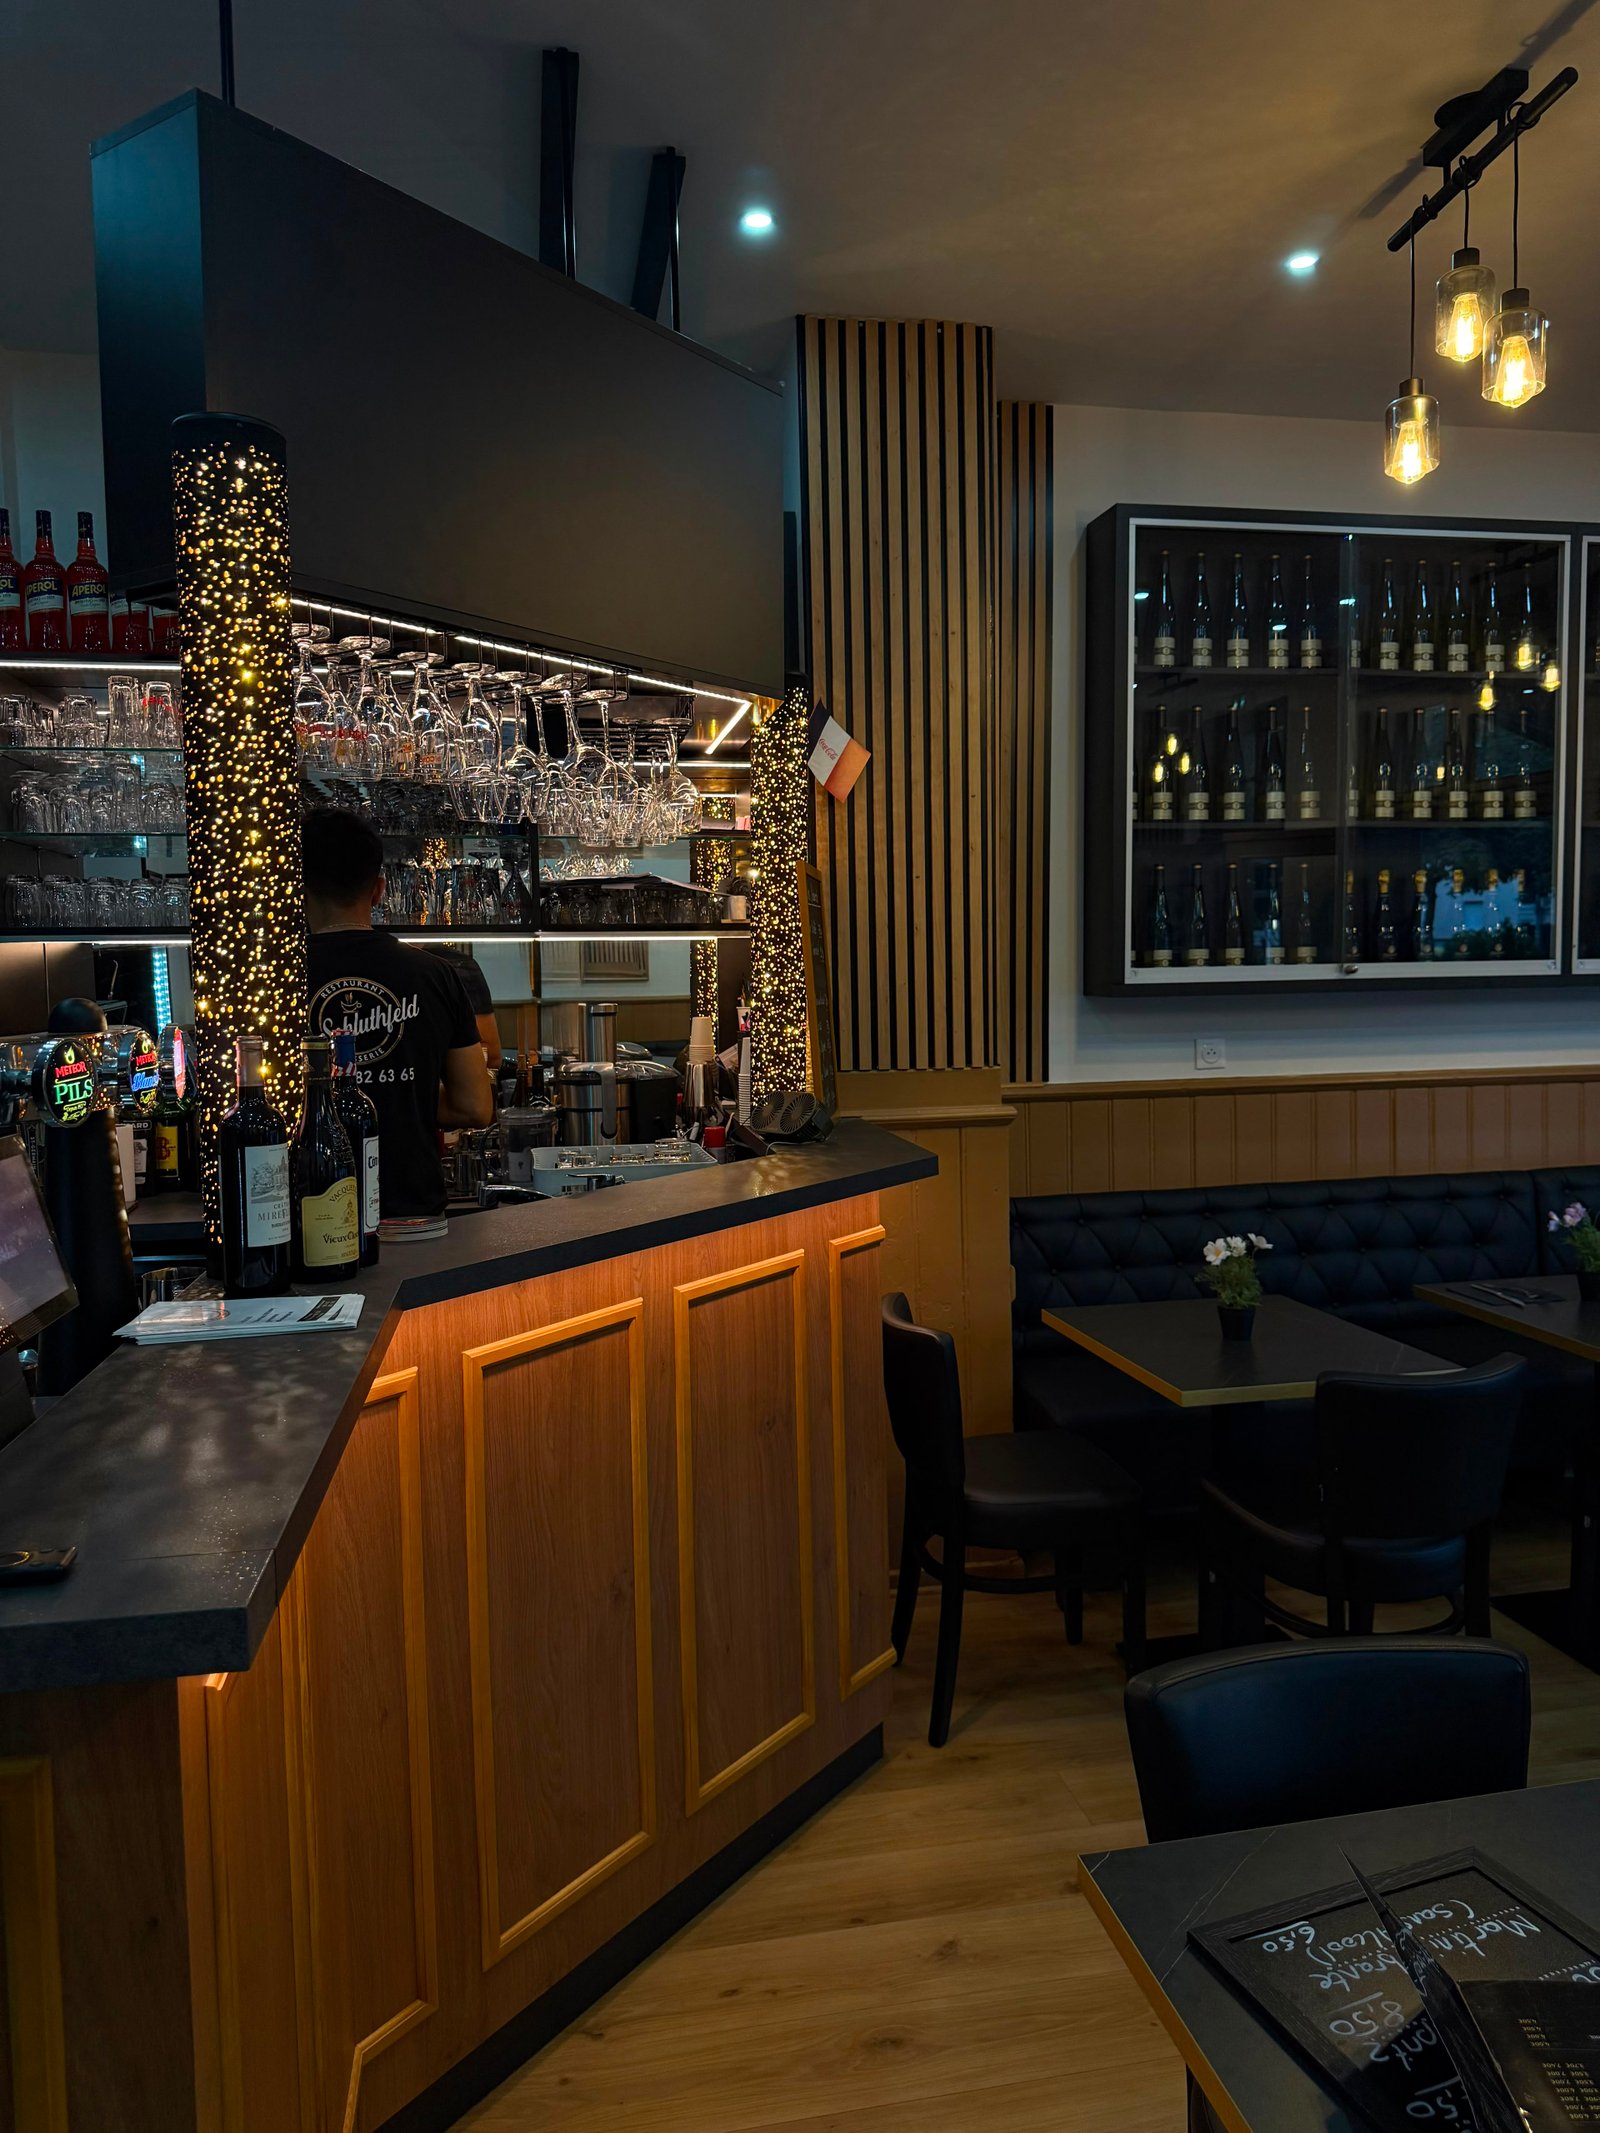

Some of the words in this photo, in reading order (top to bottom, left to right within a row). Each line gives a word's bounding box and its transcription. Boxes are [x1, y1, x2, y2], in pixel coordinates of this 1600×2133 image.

[72, 583, 107, 597] APEROL
[320, 980, 386, 999] RESTAURANT
[322, 993, 420, 1037] Shluthfeld
[55, 1061, 87, 1078] METEOR
[356, 1070, 373, 1084] 82
[379, 1069, 395, 1082] 63
[400, 1067, 415, 1081] 65
[54, 1078, 93, 1105] PILS
[1262, 1926, 1316, 1952] 6,50
[1429, 1914, 1541, 1957] Martini
[1308, 1952, 1408, 1992] brante
[1329, 2000, 1405, 2037] 8,50
[1406, 2088, 1468, 2120] ,50
